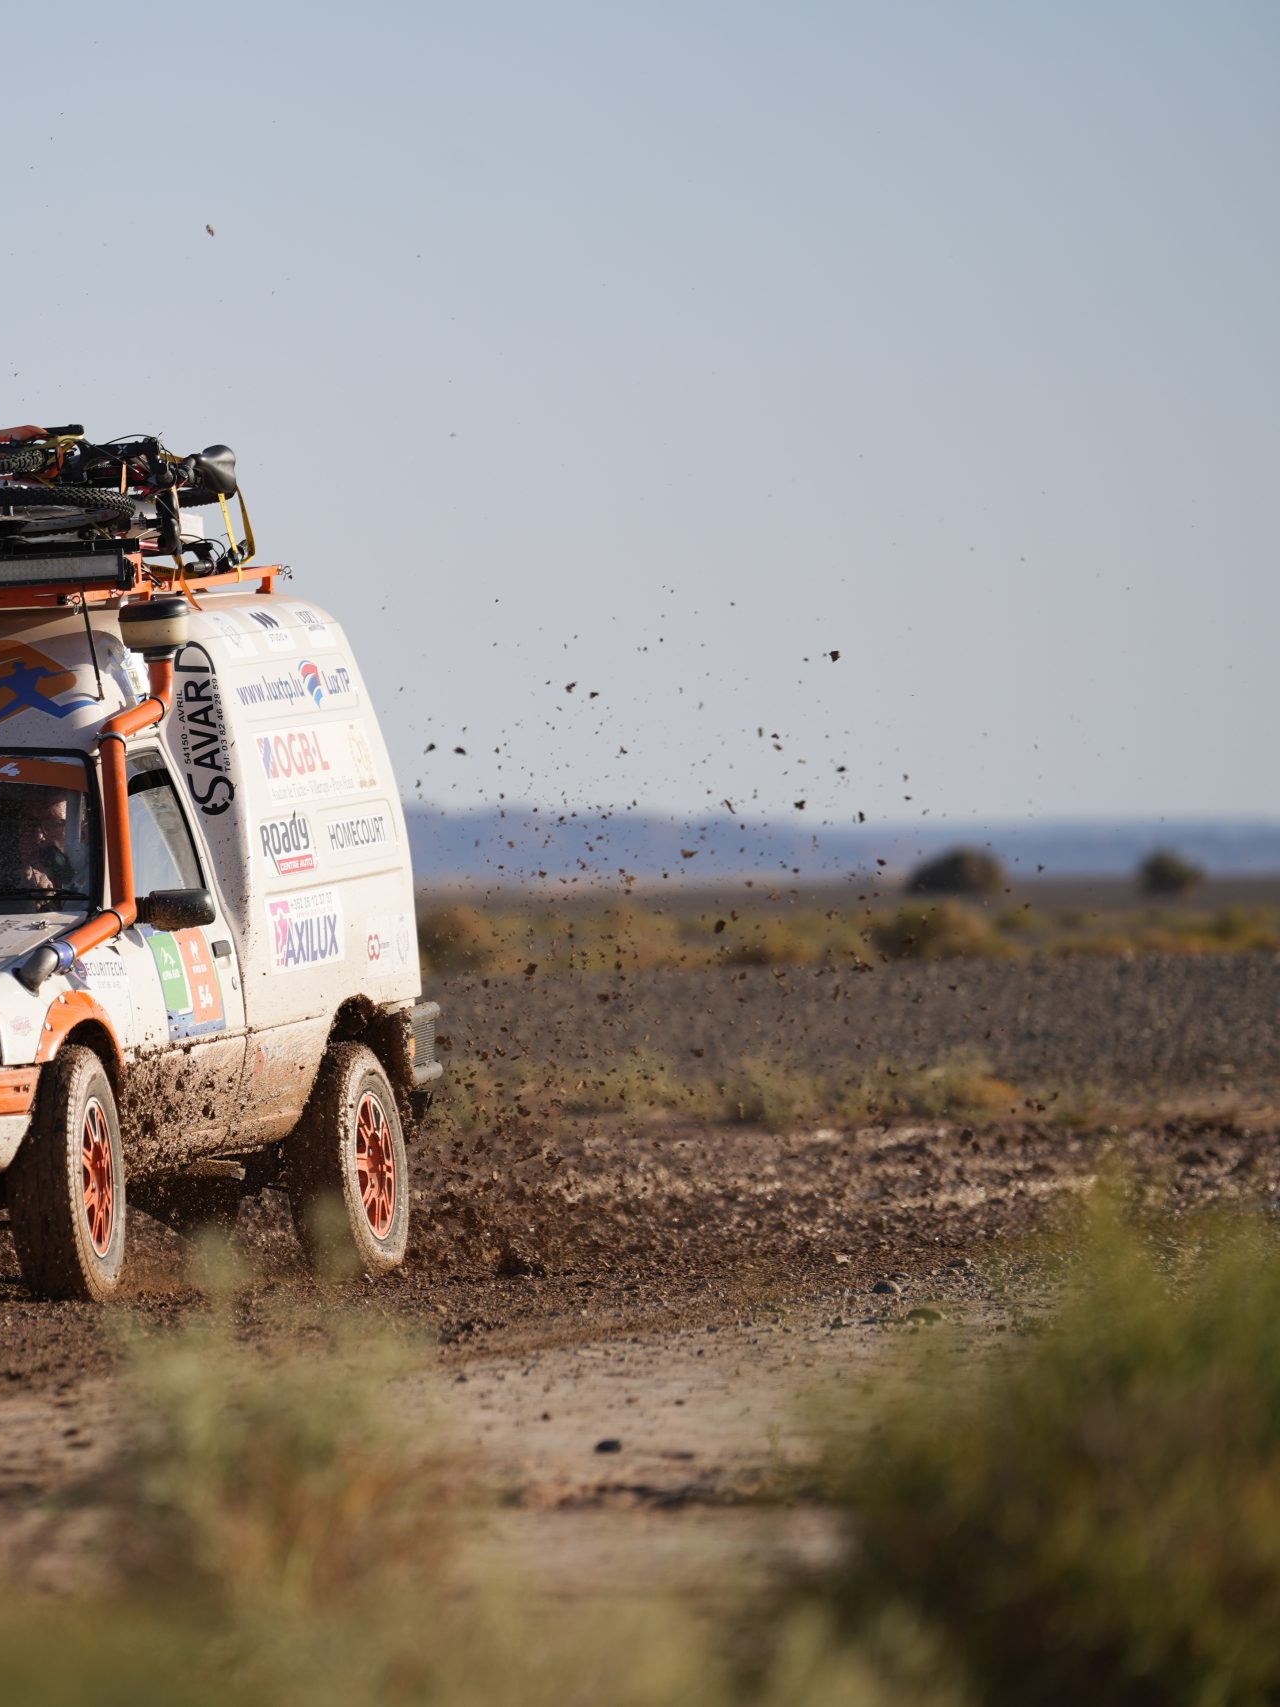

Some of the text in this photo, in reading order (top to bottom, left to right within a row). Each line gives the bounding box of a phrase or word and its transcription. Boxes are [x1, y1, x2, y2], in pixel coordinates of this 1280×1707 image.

[212, 678, 219, 690] 59
[176, 689, 186, 723] AVRIL
[215, 693, 222, 706] 28
[217, 708, 224, 721] 46
[219, 723, 226, 734] 82
[181, 734, 192, 764] 54150
[221, 739, 228, 750] 03
[328, 816, 385, 850] HOMECOURT
[197, 984, 213, 1009] 54
